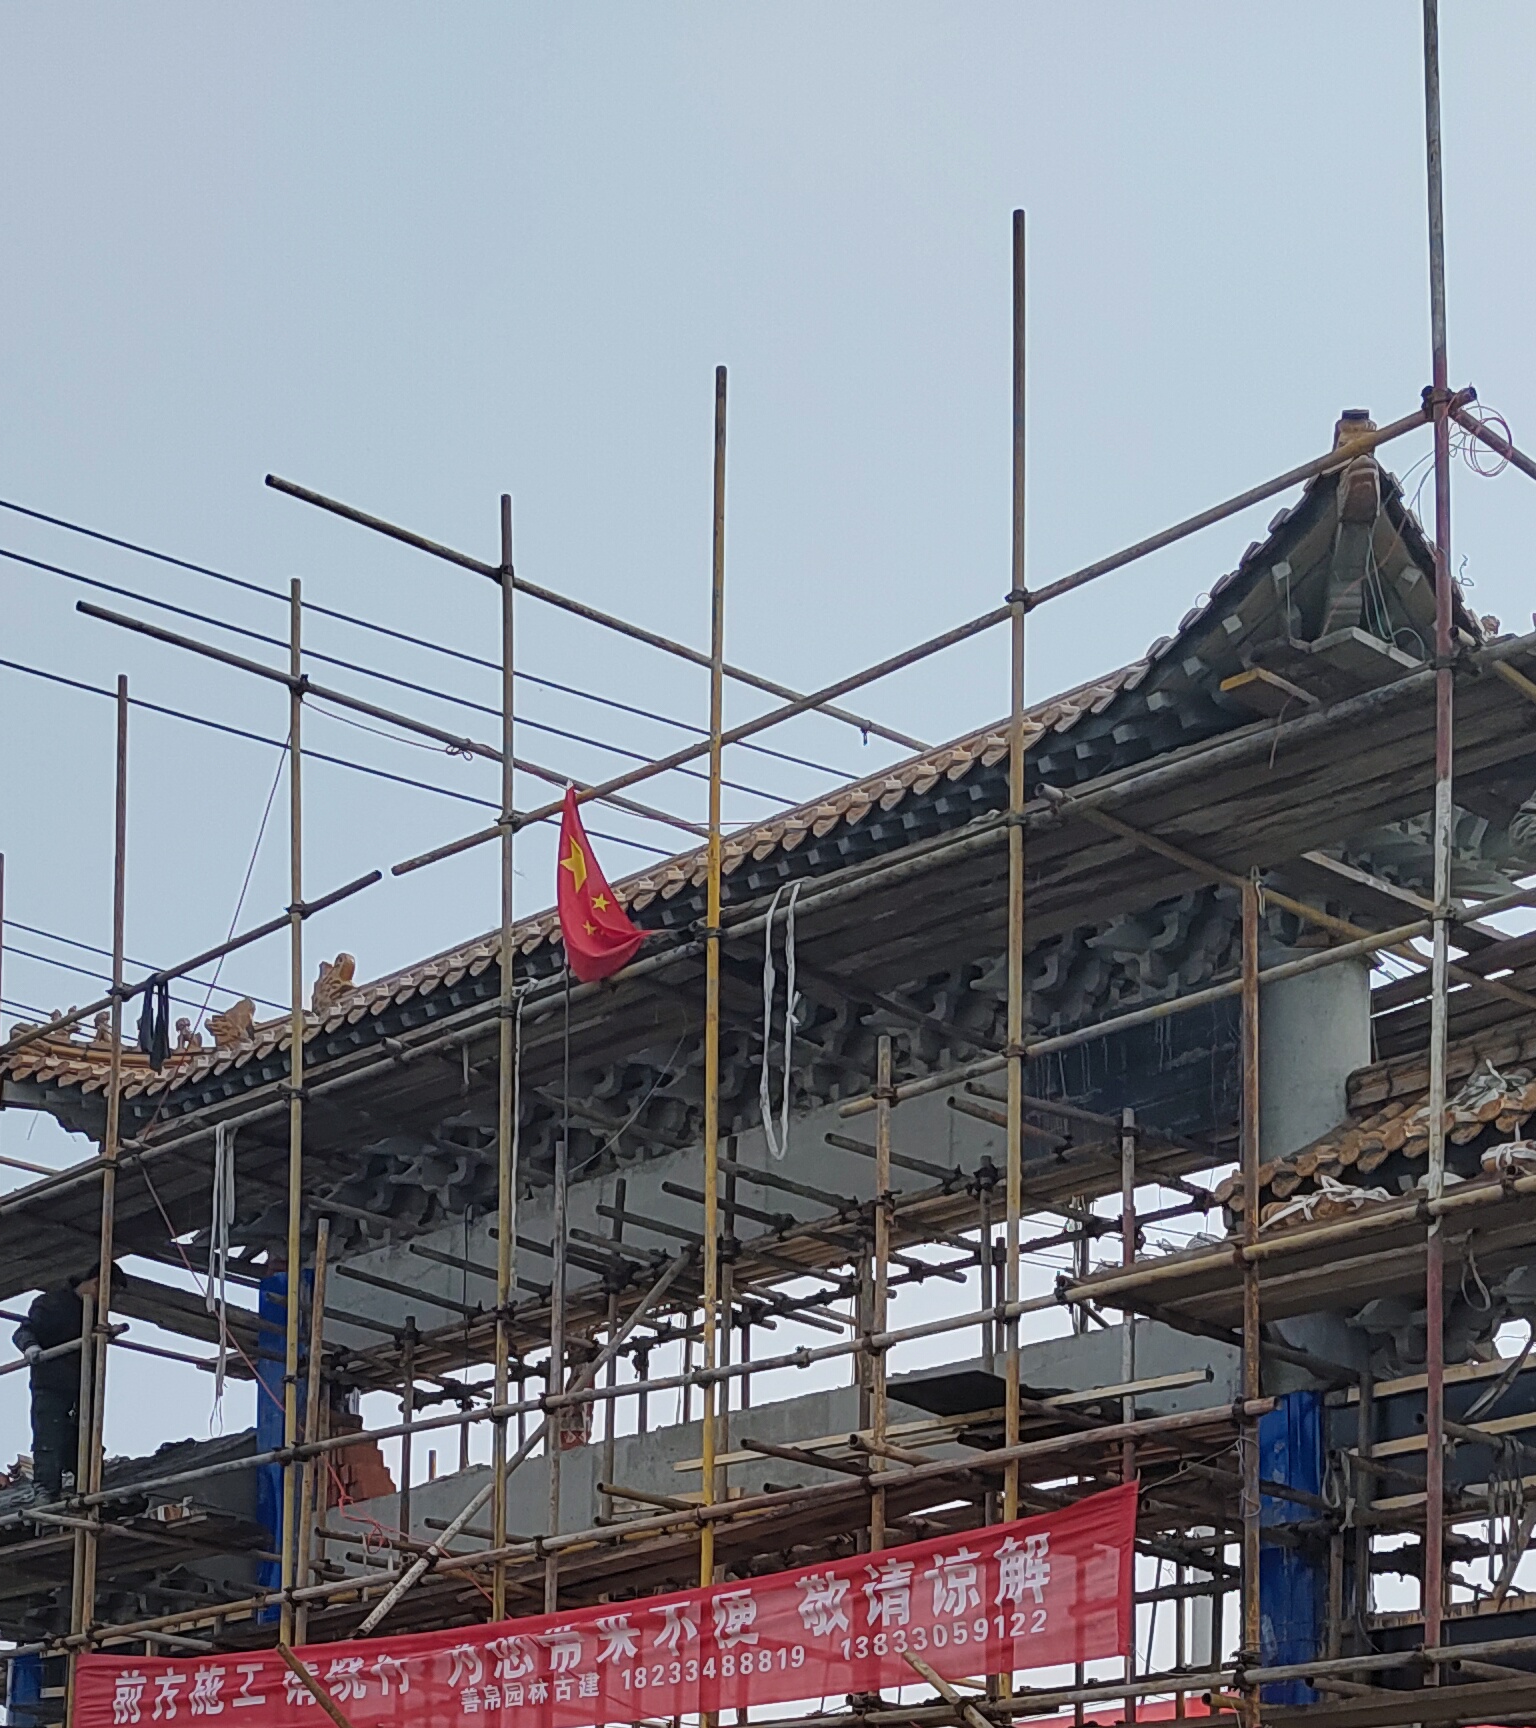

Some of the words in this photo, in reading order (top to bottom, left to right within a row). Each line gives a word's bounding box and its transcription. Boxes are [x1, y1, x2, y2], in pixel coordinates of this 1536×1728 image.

[113, 1663, 267, 1725] 前方施工
[445, 1587, 760, 1688] 为您带来不便
[795, 1531, 1051, 1637] 敬请谅解
[620, 1645, 806, 1691] 18233488819
[840, 1609, 1049, 1661] 13833059122
